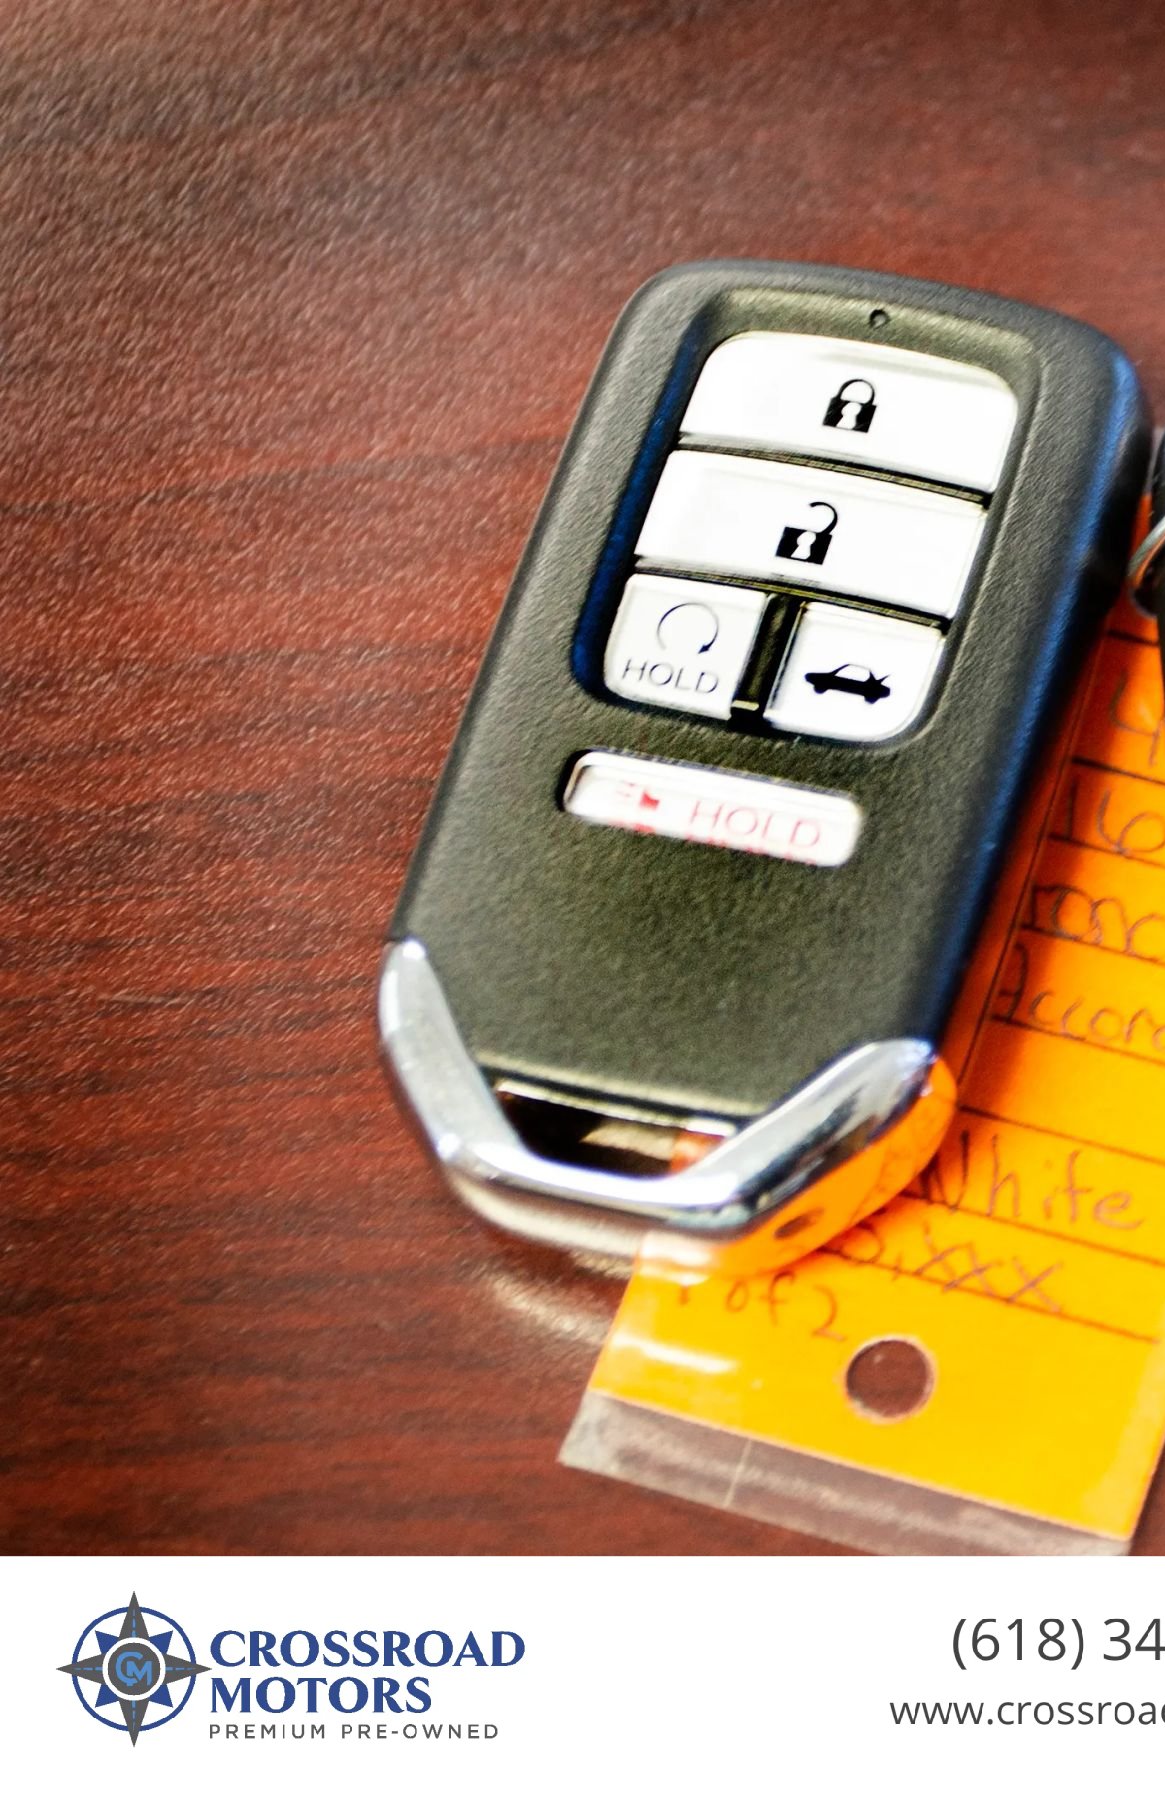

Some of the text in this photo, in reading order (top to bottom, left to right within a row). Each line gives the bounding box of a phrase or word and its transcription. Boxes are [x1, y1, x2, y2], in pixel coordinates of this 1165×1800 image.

[621, 657, 720, 695] HOLD
[689, 799, 822, 849] HOLD
[811, 1283, 848, 1342] 2
